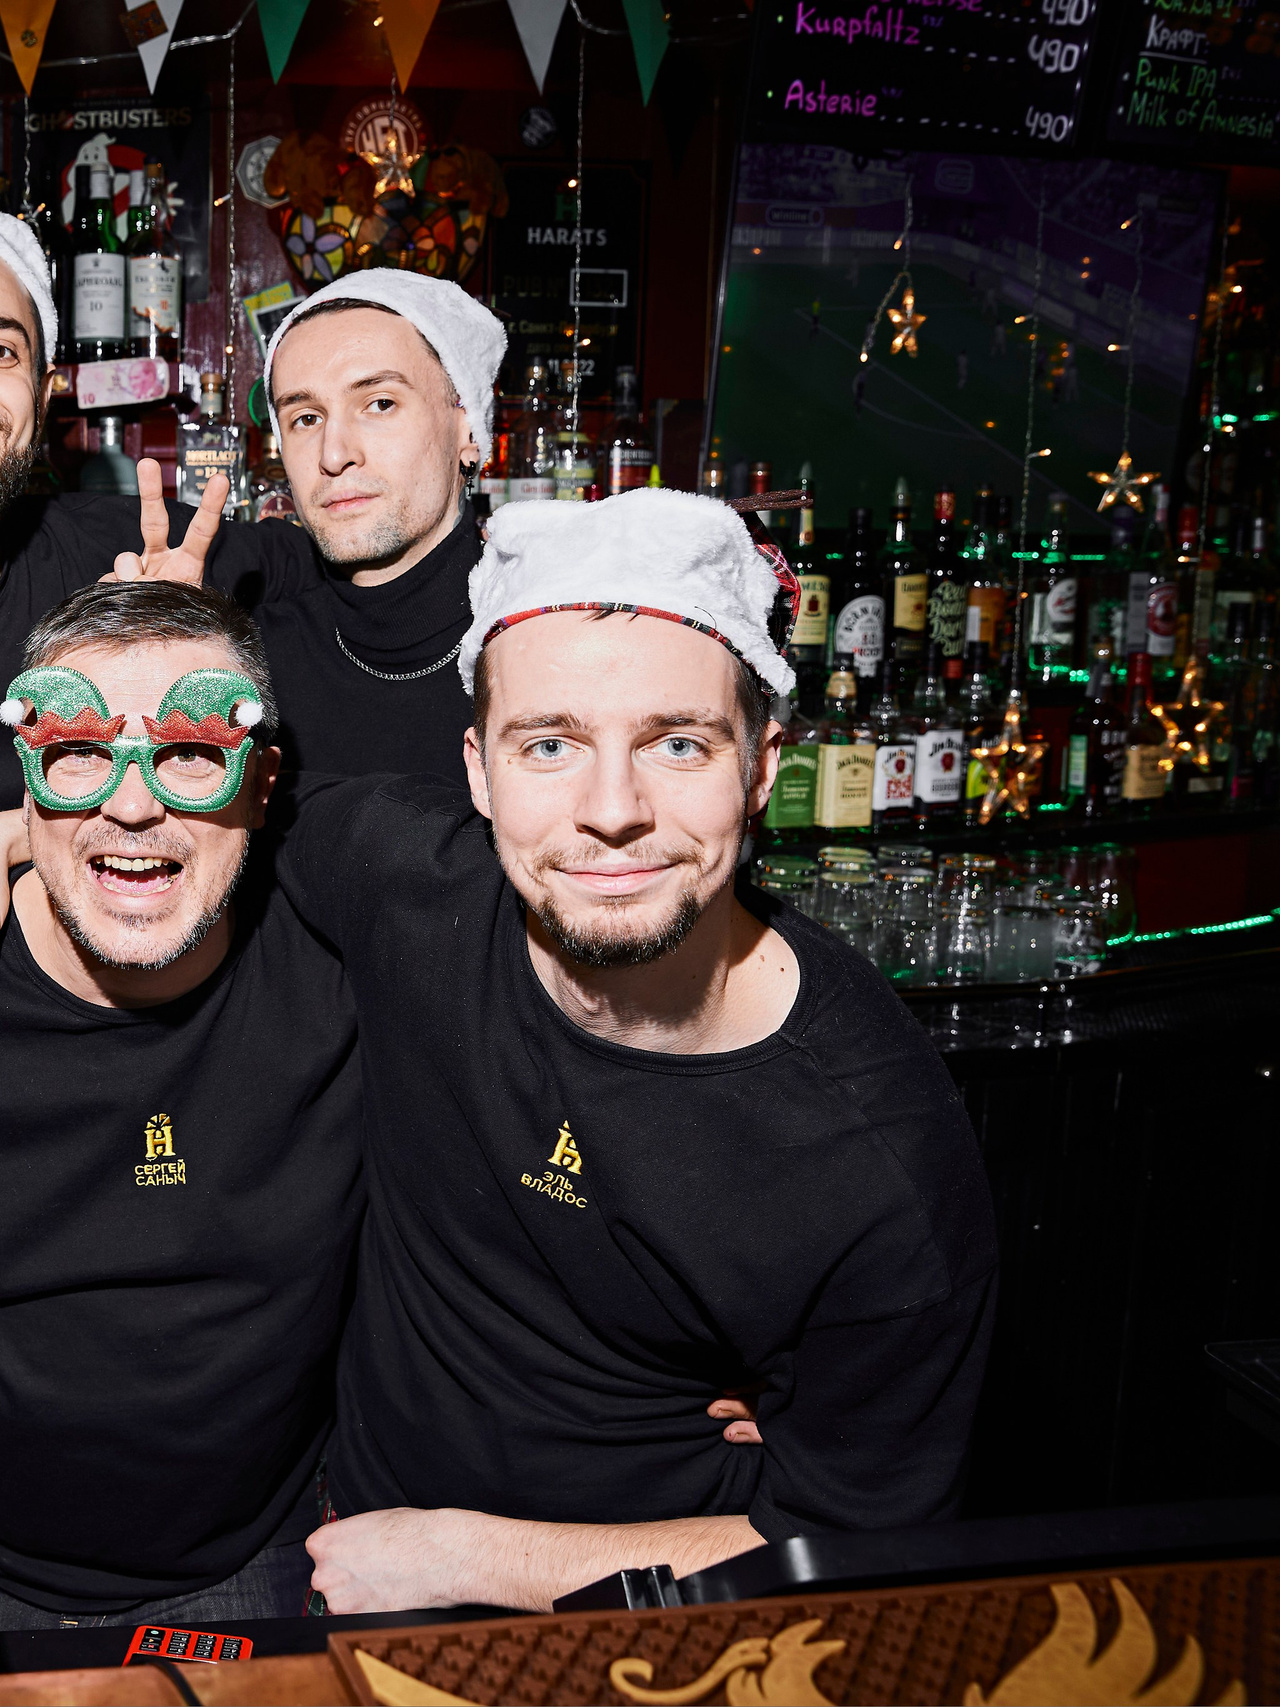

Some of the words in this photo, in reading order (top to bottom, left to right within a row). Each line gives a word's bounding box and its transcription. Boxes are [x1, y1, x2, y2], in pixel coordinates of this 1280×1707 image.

[795, 1, 920, 44] Kurpfaltz
[1028, 35, 1080, 73] 490
[1135, 58, 1179, 94] Punk
[1186, 65, 1218, 98] IPA
[784, 79, 877, 117] Asterie
[1025, 105, 1070, 142] 490
[1127, 90, 1167, 126] Milk
[1175, 100, 1200, 126] of
[1200, 99, 1274, 140] Amnesia
[526, 226, 608, 247] HARATS
[134, 1159, 186, 1175] СЕРГЕЙ
[135, 1174, 186, 1186] САНЫЧ
[542, 1171, 573, 1191] ЭЛЬ
[520, 1173, 588, 1208] ВЛАДОС
